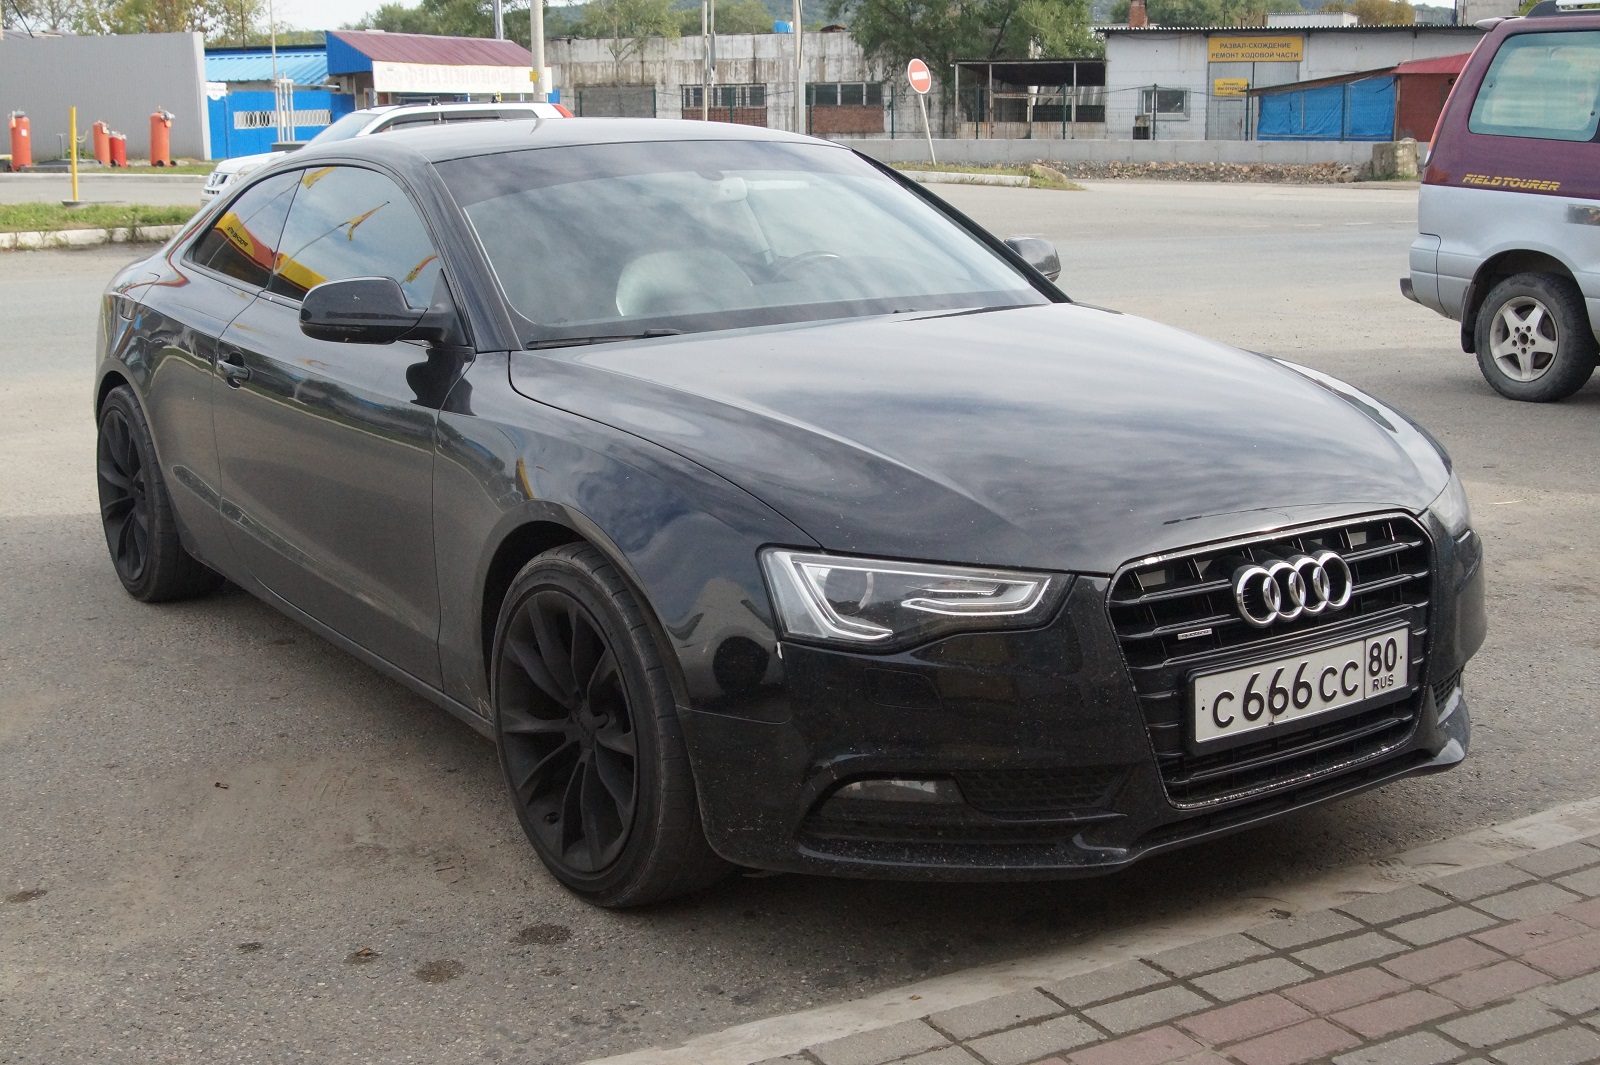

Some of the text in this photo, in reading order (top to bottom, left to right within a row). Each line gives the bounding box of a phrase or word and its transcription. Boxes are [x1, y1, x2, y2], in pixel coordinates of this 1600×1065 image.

[1240, 51, 1275, 59] ХОДОВОЙ
[1462, 173, 1561, 191] FIELDTOURER
[1368, 637, 1398, 677] 80
[1372, 674, 1394, 692] RUS
